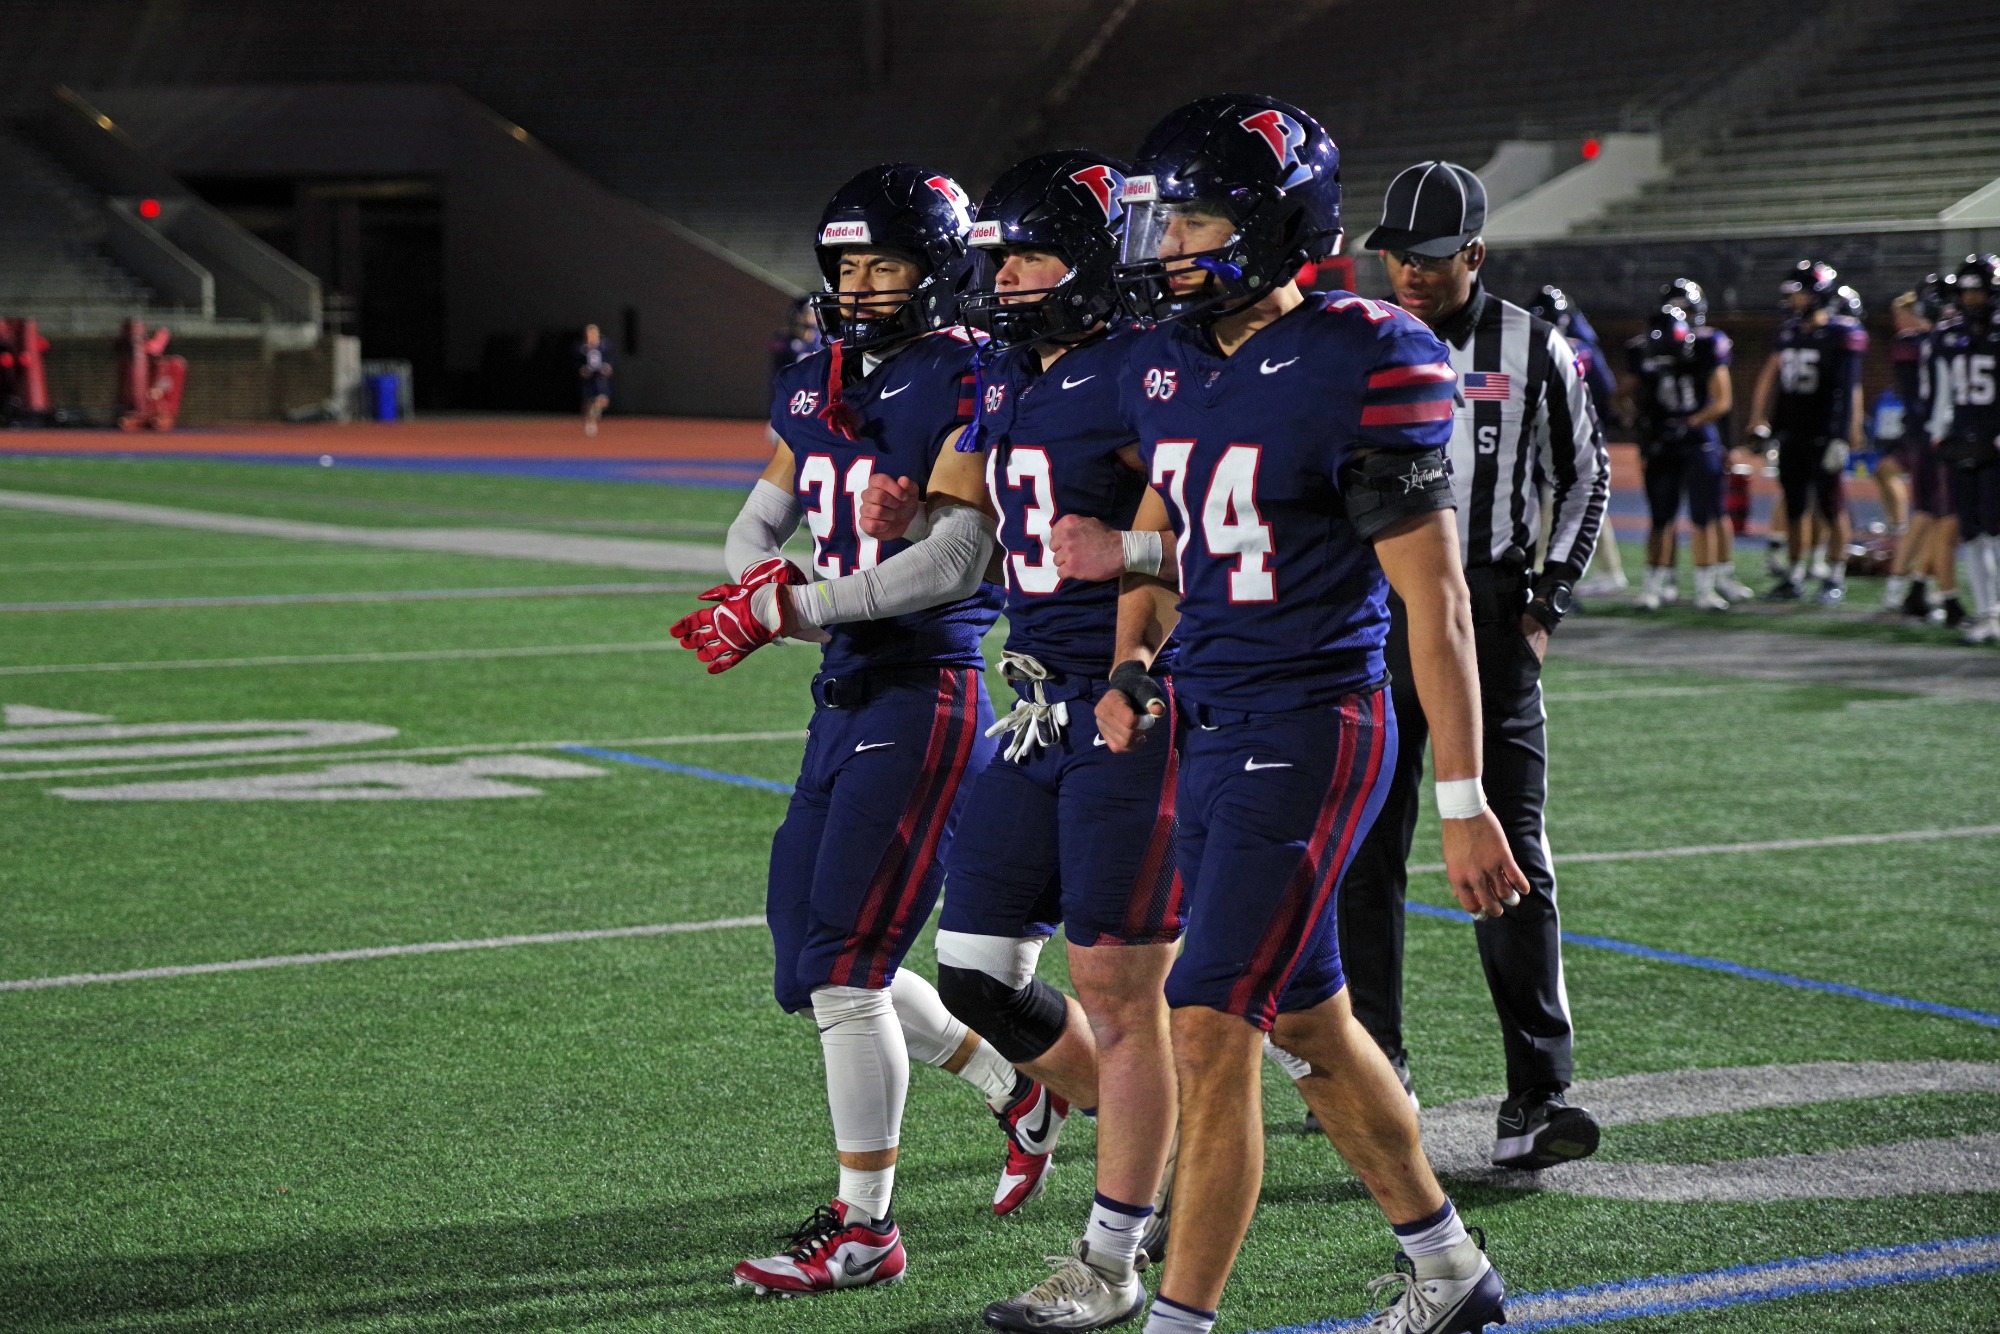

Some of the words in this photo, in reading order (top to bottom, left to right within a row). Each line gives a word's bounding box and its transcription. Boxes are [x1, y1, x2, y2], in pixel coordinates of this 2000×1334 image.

[825, 225, 864, 239] Riddell
[984, 385, 1006, 413] 95
[1143, 367, 1178, 401] 95
[788, 388, 820, 416] 95
[1477, 425, 1499, 455] S
[800, 453, 880, 579] 21
[1150, 438, 1278, 605] 74
